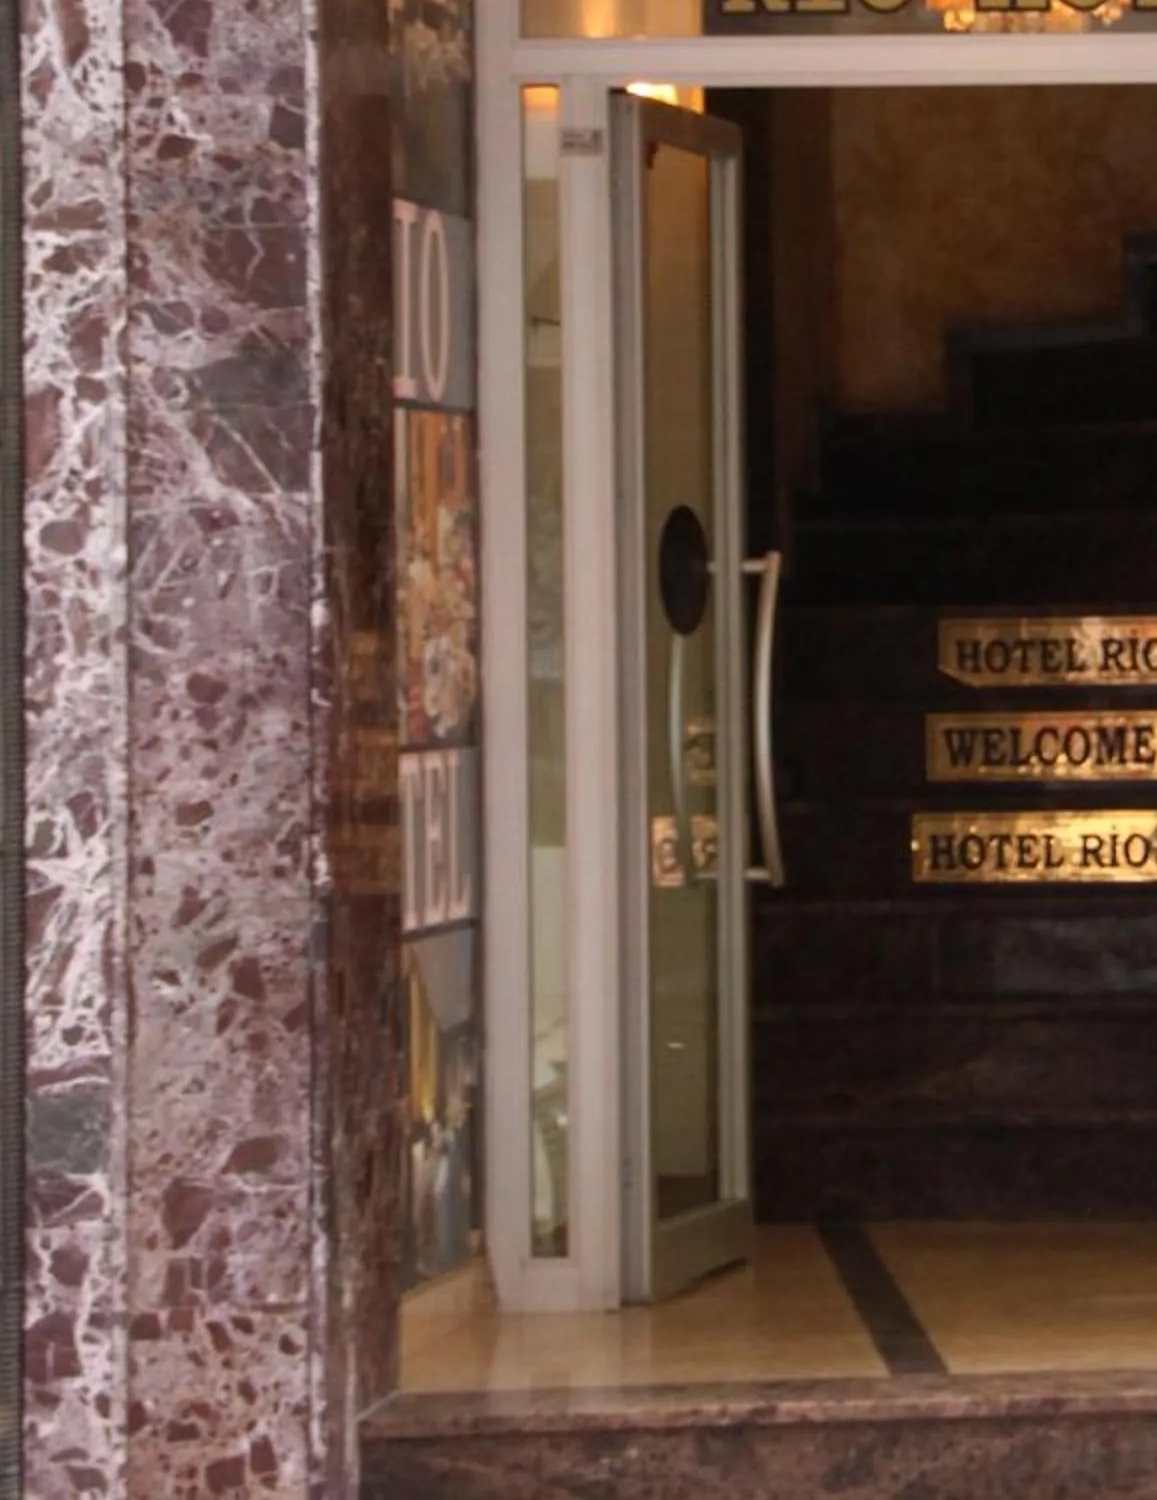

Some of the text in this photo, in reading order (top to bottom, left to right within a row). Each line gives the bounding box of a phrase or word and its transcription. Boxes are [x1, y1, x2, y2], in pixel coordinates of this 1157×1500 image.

[955, 637, 1088, 674] HOTEL
[943, 726, 1156, 767] WELCOME
[929, 833, 1064, 870] HOTEL
